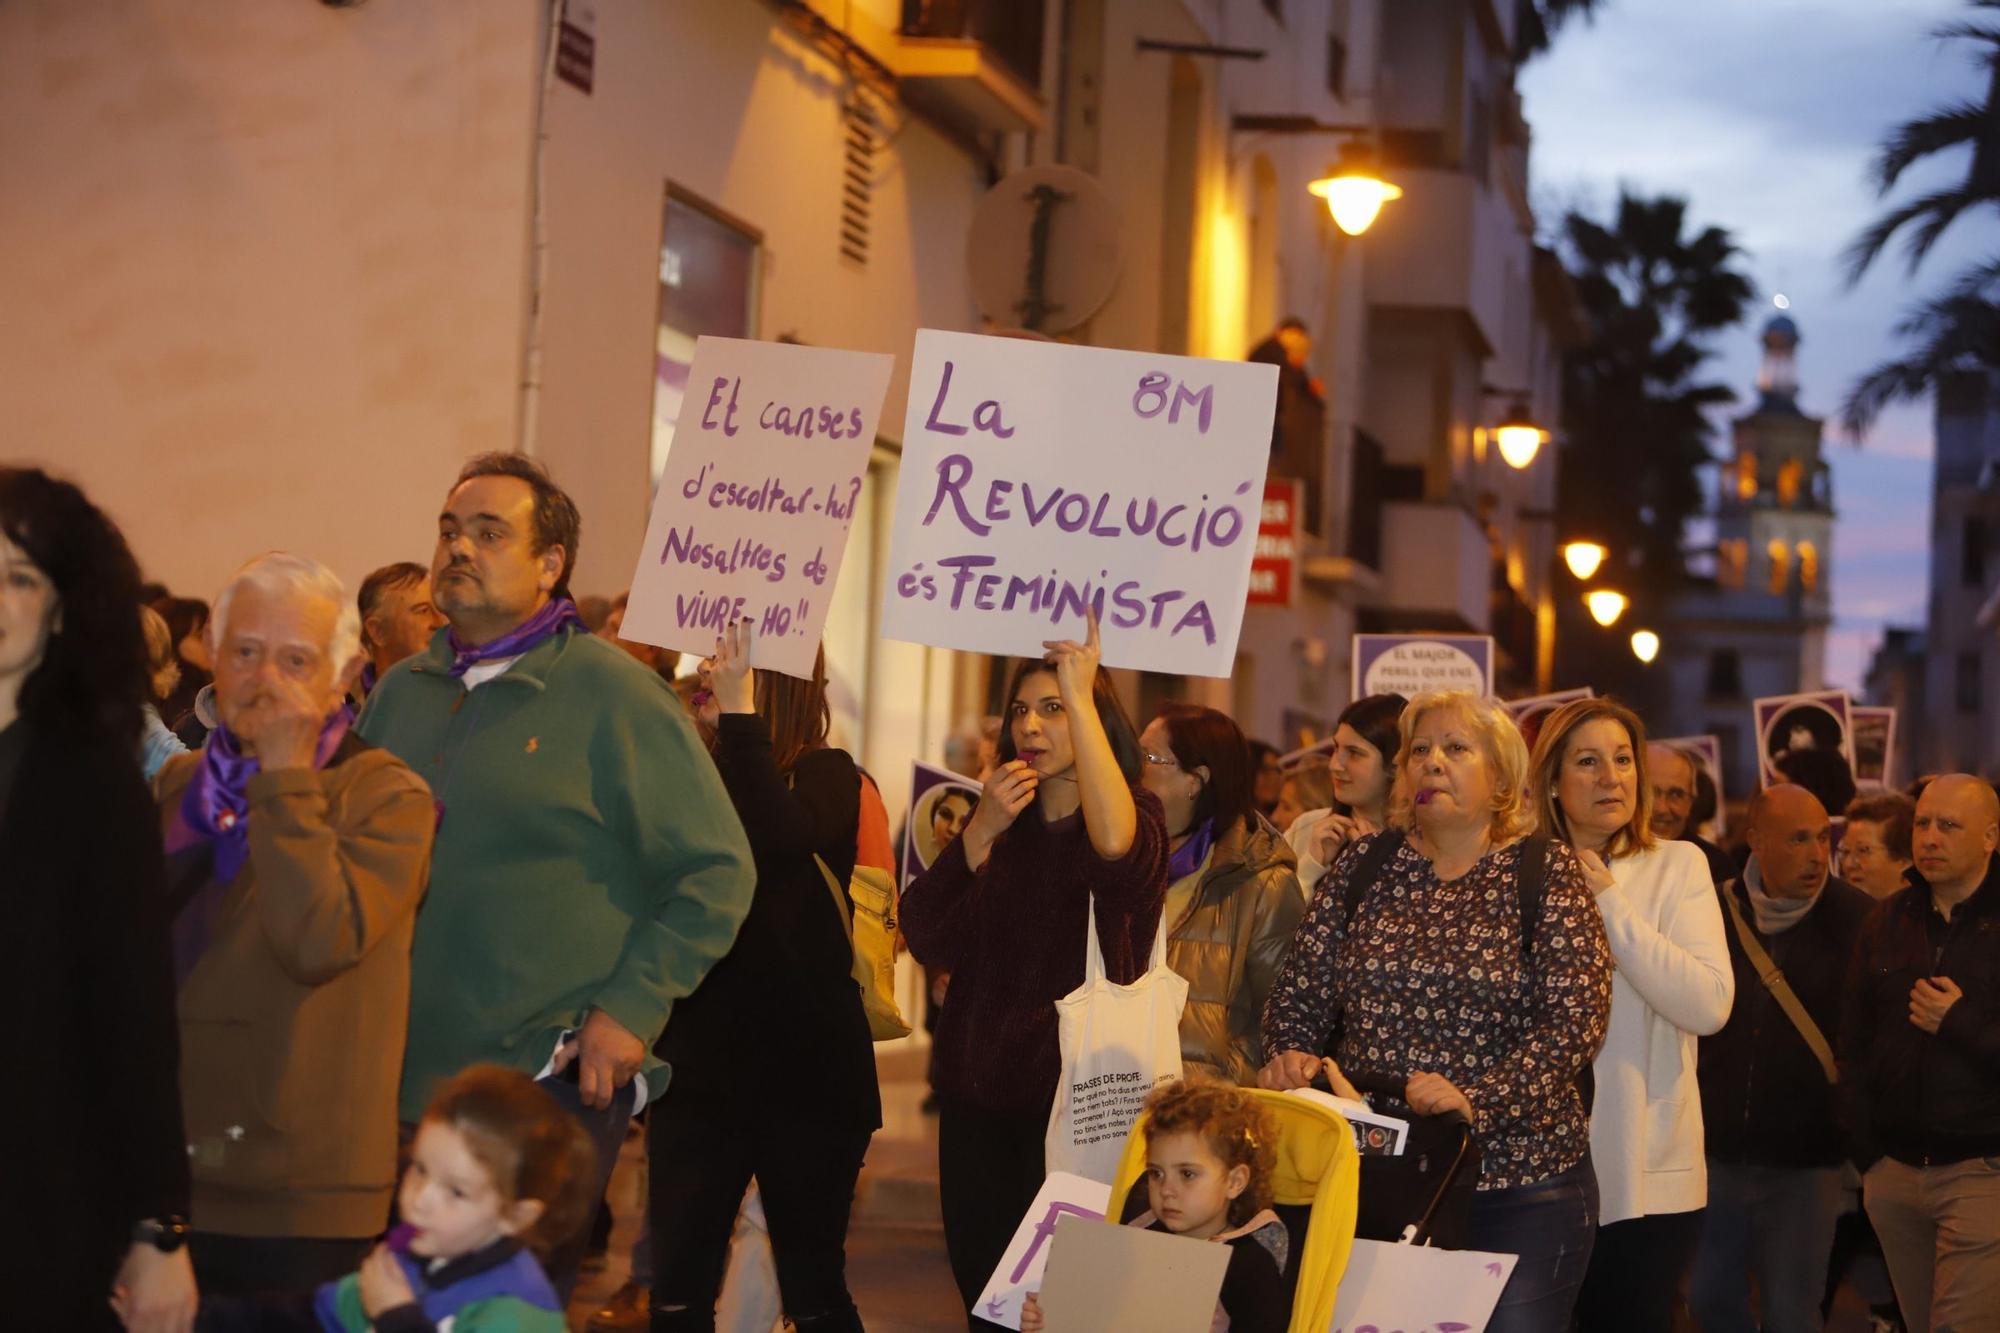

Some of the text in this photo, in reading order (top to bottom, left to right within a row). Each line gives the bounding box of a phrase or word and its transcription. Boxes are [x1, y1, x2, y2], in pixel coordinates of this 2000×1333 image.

[701, 376, 863, 440] Et canses
[924, 361, 1015, 439] La
[1132, 371, 1214, 434] 8M
[661, 525, 828, 585] Nosaltres de
[897, 562, 938, 601] és
[1394, 650, 1456, 662] EL MAJOR
[1421, 667, 1447, 678] QUE
[1073, 1076, 1102, 1094] FRASES
[1103, 1073, 1115, 1084] DE
[1116, 1072, 1142, 1083] PROFE:
[1073, 1096, 1085, 1105] Per
[1098, 1089, 1107, 1097] no
[1108, 1087, 1117, 1096] ho
[1118, 1086, 1131, 1094] dius
[1073, 1107, 1086, 1115] ens
[1101, 1096, 1118, 1108] tots?
[1084, 1125, 1097, 1134] tinc
[1073, 1136, 1088, 1147] fins
[1088, 1135, 1101, 1145] que
